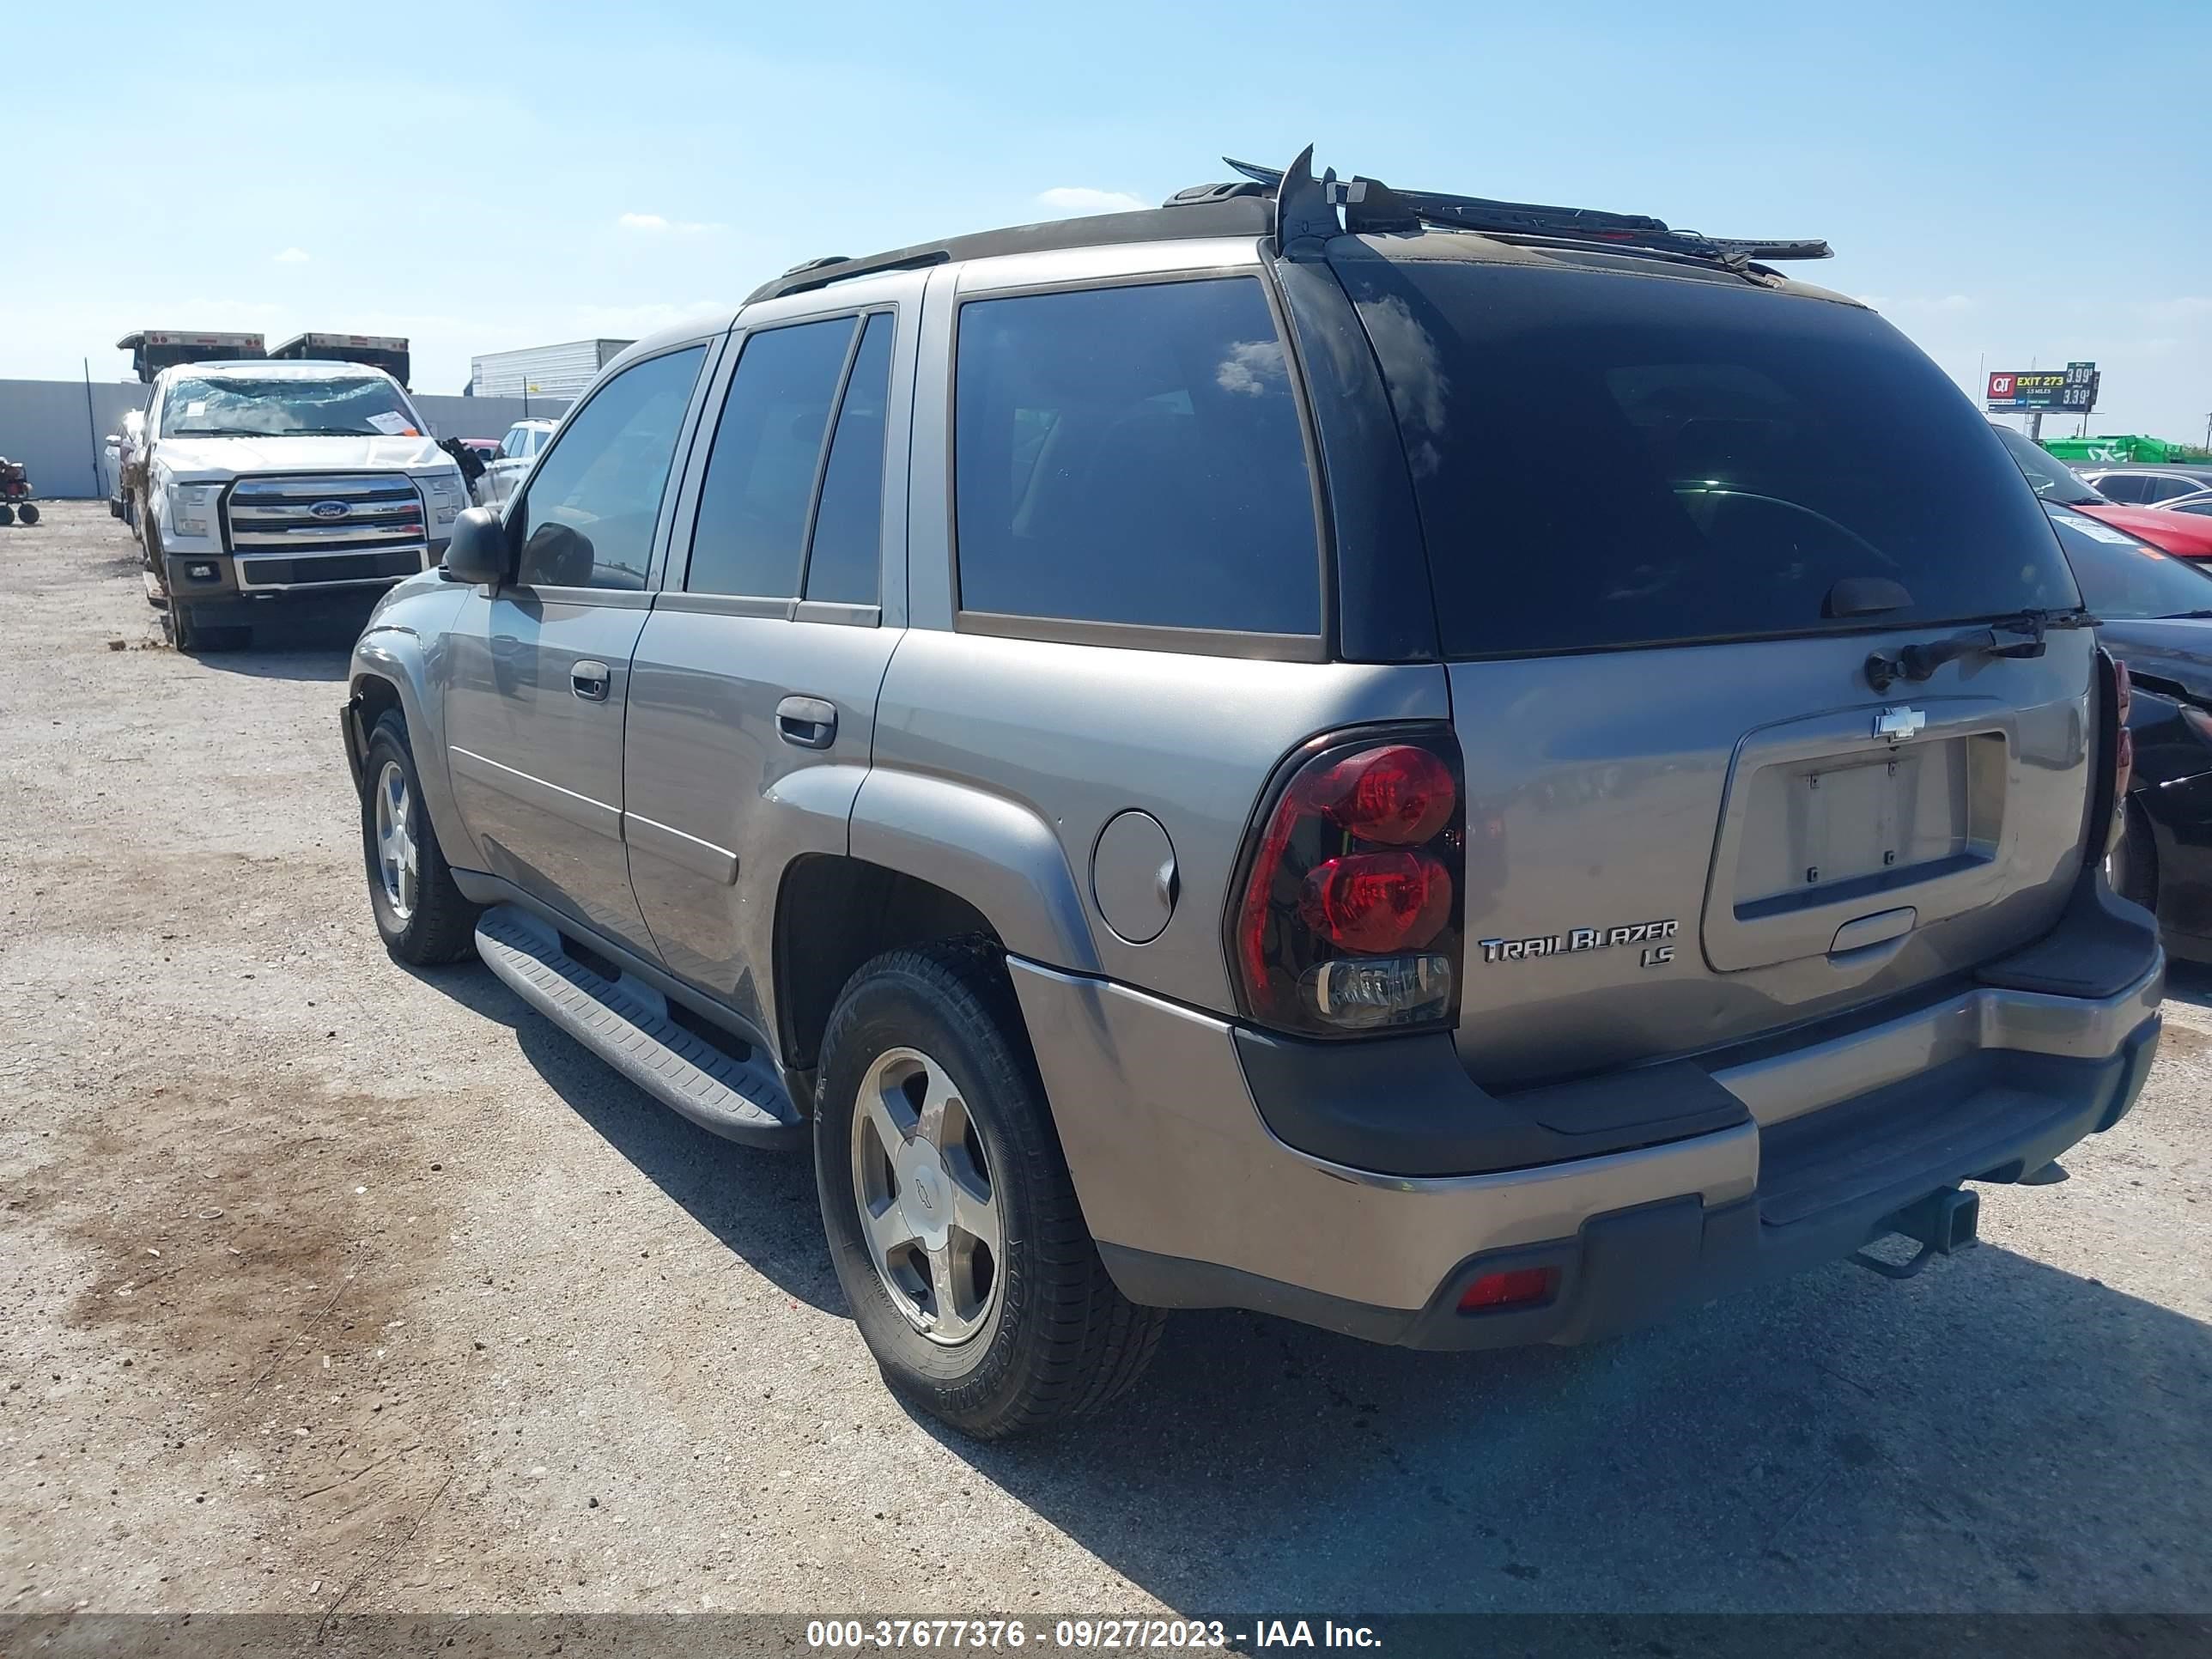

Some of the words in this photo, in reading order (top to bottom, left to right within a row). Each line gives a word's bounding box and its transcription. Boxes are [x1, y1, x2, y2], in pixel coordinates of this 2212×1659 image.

[1992, 377, 2011, 393] QT
[2016, 377, 2041, 386] EXIT
[2043, 376, 2063, 386] 273
[1640, 945, 1675, 968] LS
